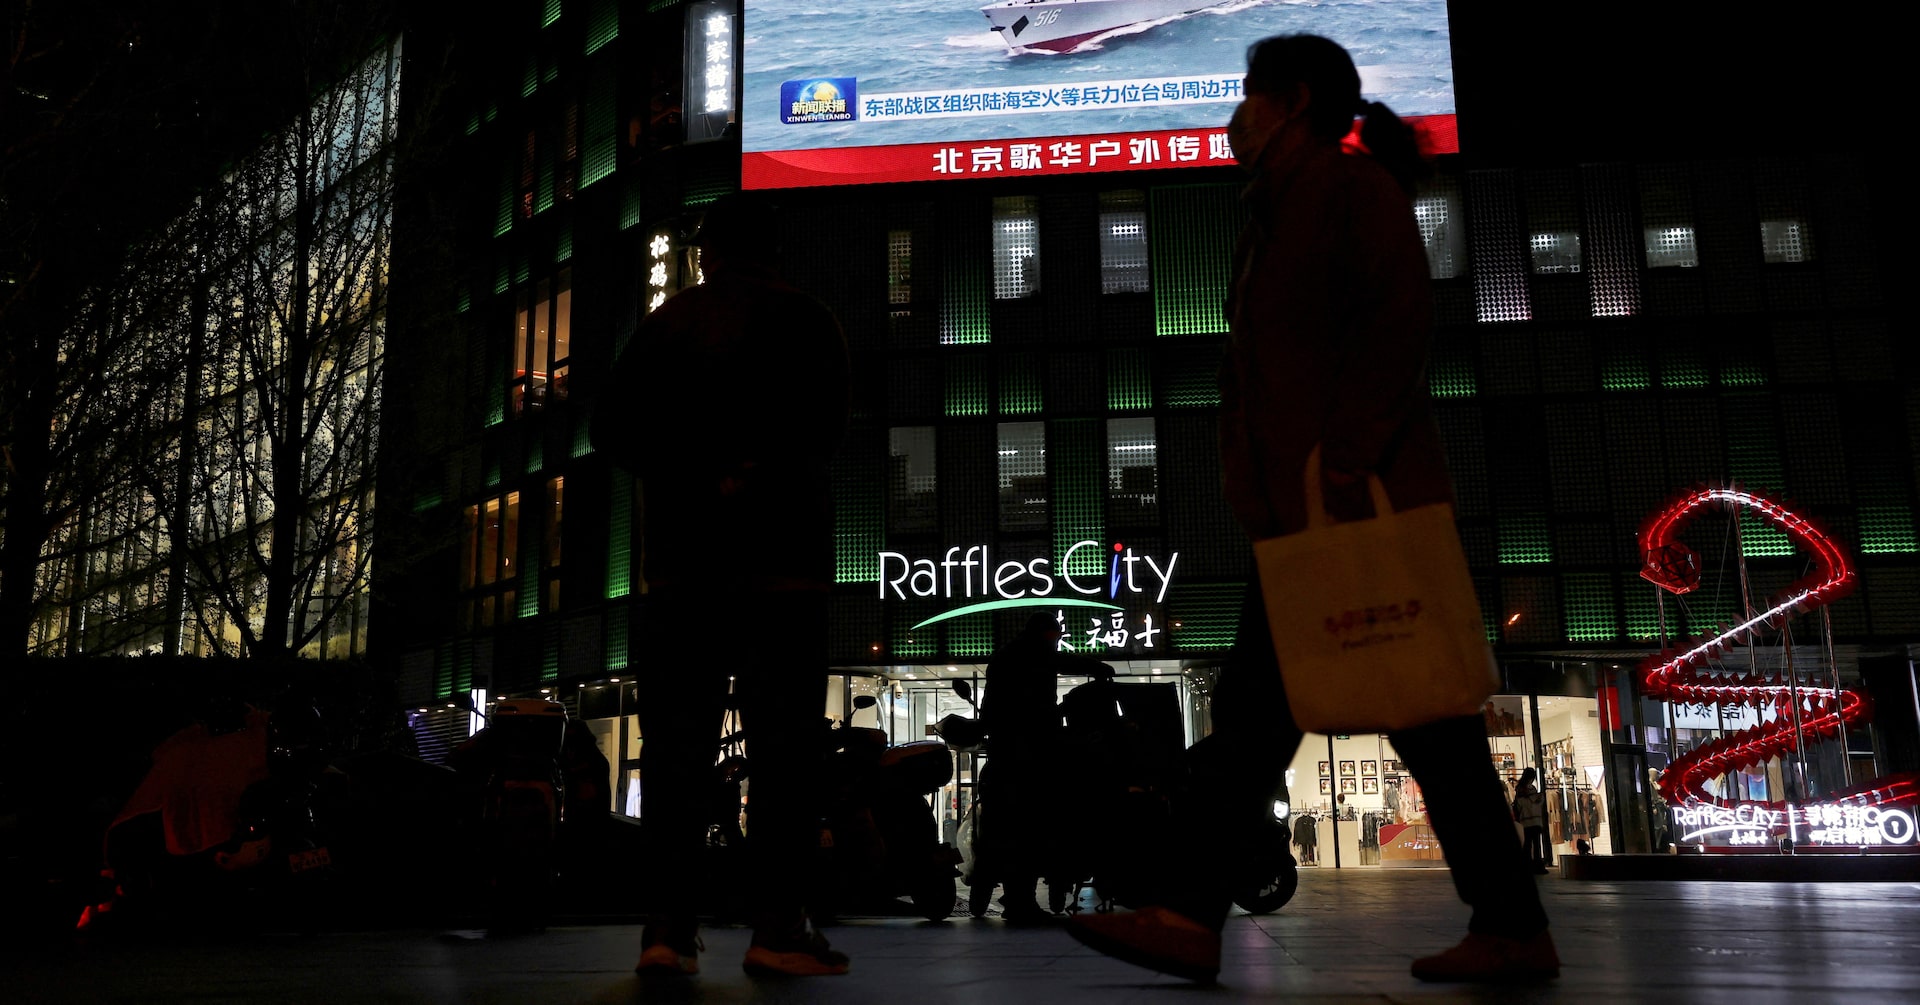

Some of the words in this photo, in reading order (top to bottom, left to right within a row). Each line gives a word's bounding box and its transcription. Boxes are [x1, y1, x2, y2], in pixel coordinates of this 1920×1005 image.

[1034, 8, 1062, 27] 516
[791, 99, 846, 115] 新闻联播
[865, 78, 1246, 117] 东部战区组织陆海空火等兵力位台岛周边开
[822, 113, 851, 121] LIANBO
[878, 544, 1054, 600] Raffles
[1062, 540, 1179, 603] City
